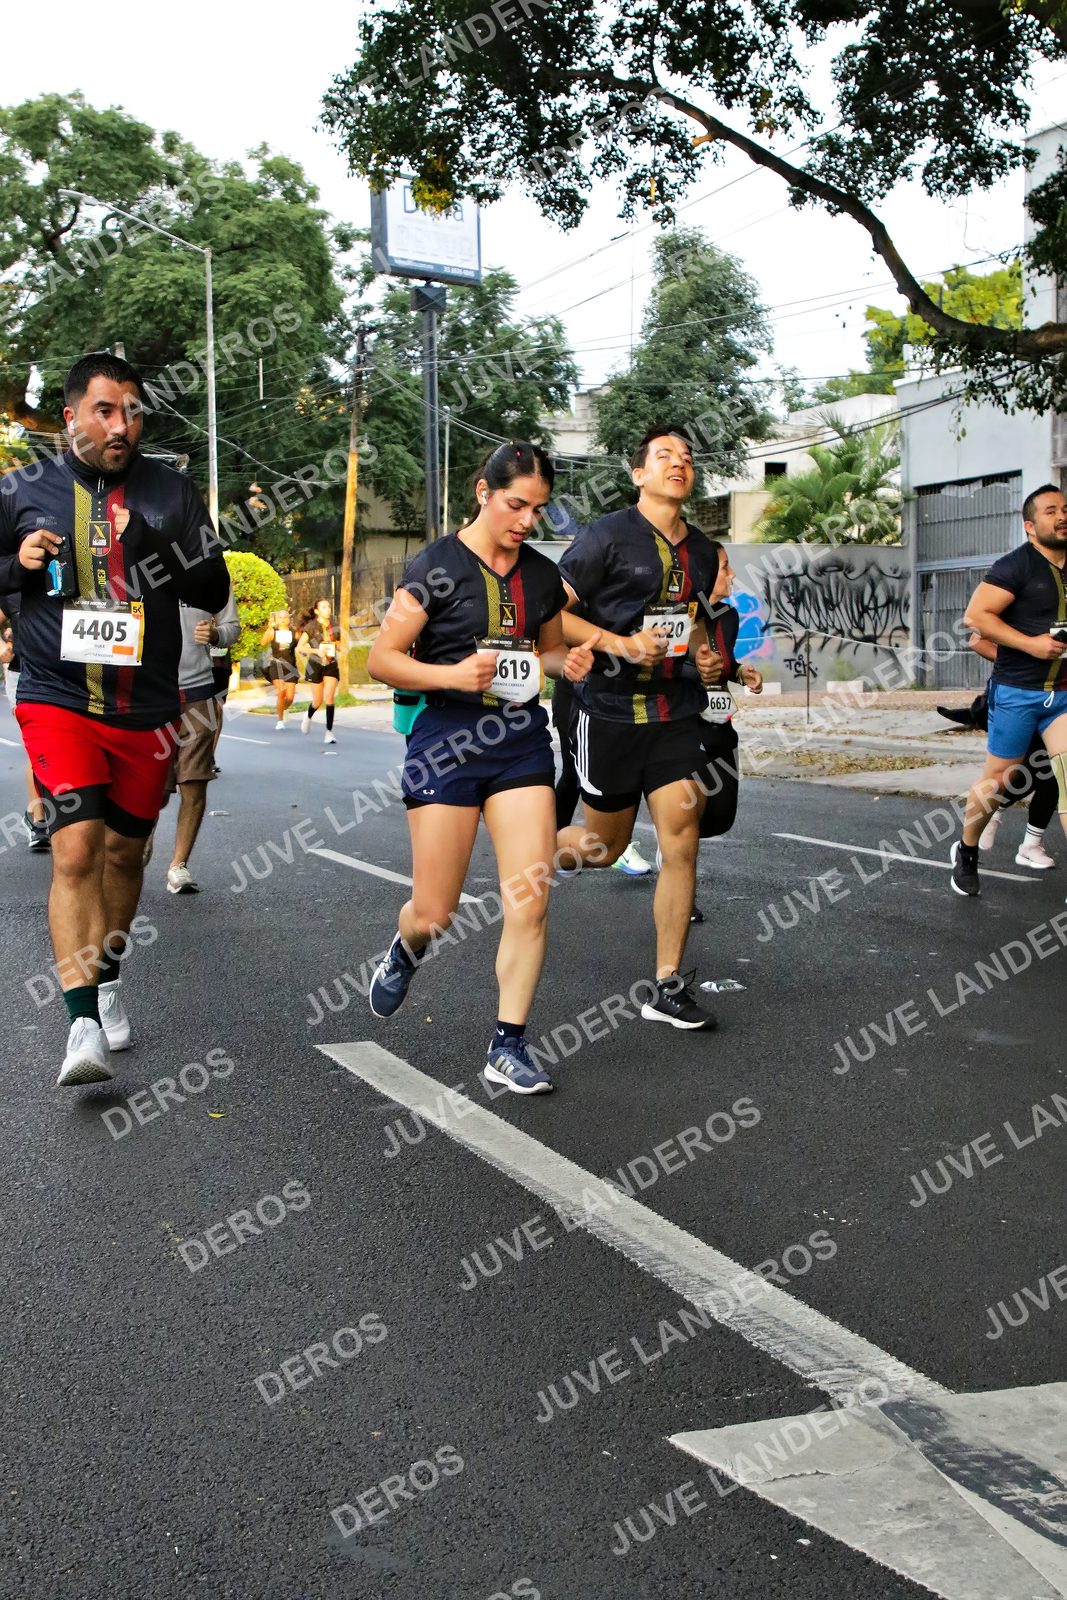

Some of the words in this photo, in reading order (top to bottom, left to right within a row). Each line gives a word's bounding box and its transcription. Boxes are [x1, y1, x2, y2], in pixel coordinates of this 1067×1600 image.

[72, 619, 127, 642] 4405
[494, 659, 531, 680] 619
[710, 697, 732, 710] 6637
